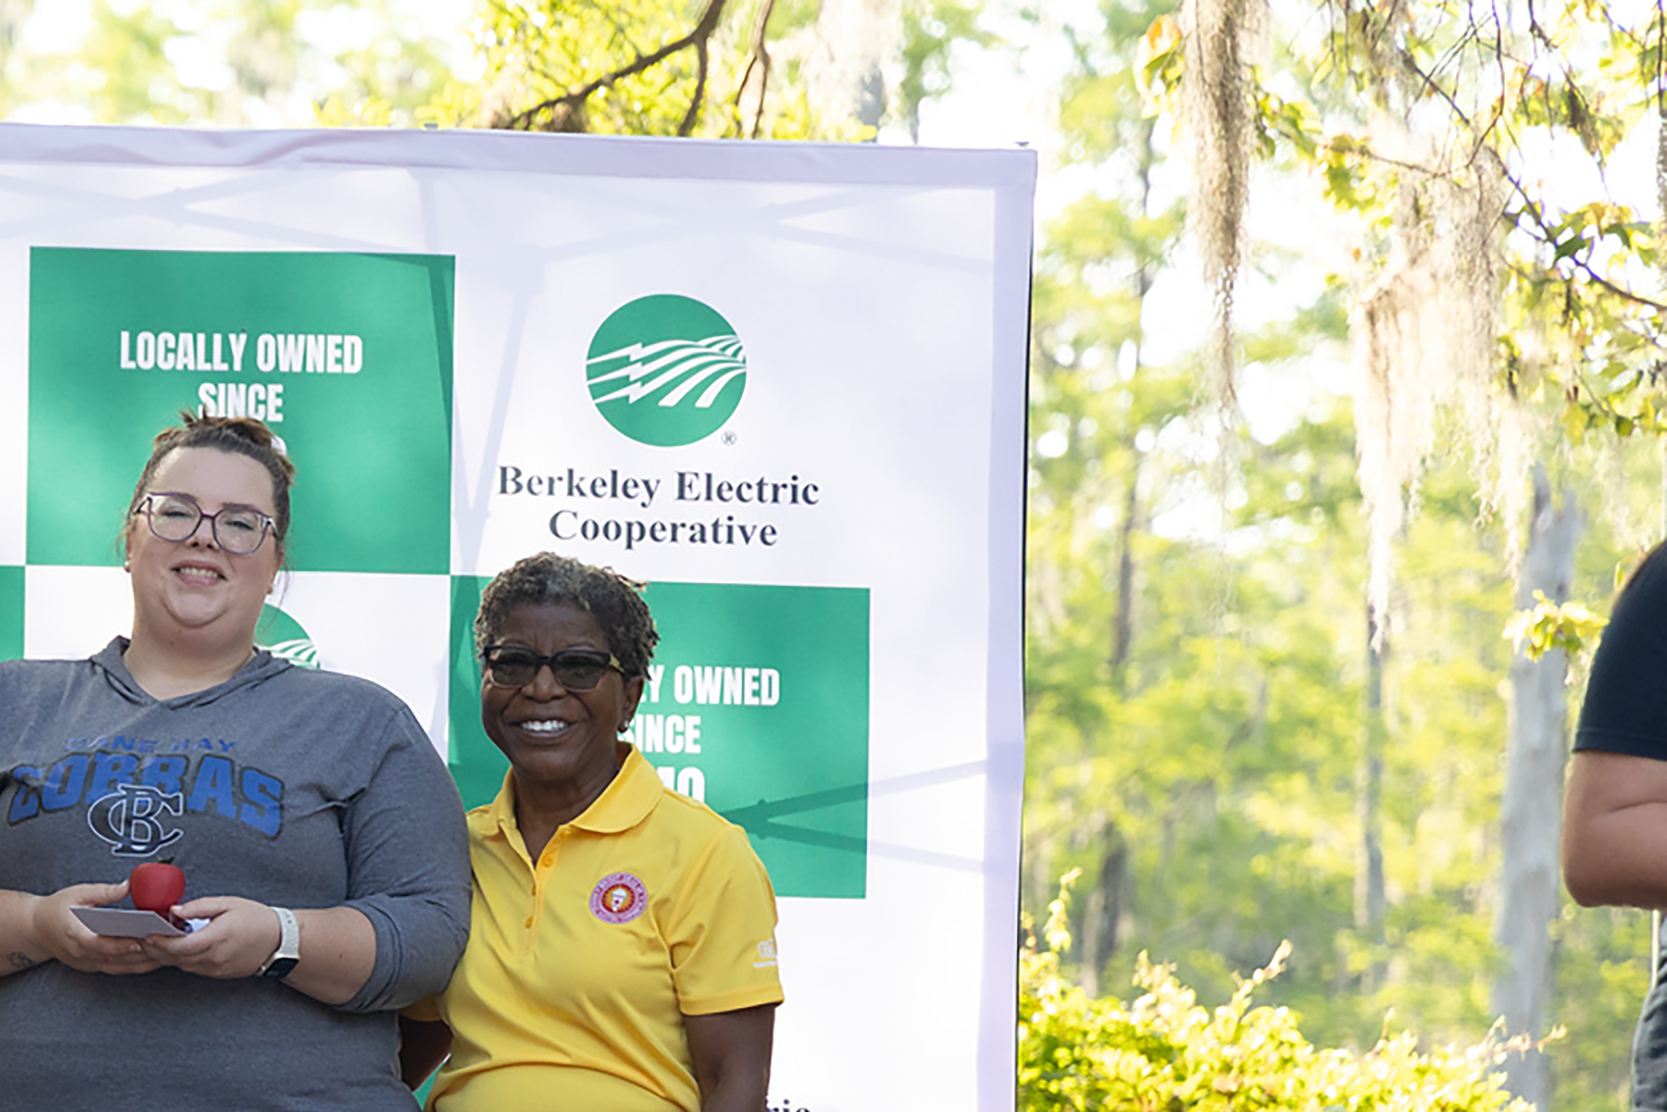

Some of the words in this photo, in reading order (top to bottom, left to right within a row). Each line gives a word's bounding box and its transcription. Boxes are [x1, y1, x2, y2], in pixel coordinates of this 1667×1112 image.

[120, 330, 247, 372] LOCALLY
[256, 333, 363, 374] OWNED
[197, 382, 283, 422] SINCE
[498, 466, 661, 508] Berkeley
[676, 471, 820, 505] Electric
[548, 509, 778, 550] Cooperative
[674, 665, 780, 706] OWNED
[6, 749, 284, 840] COBRAS
